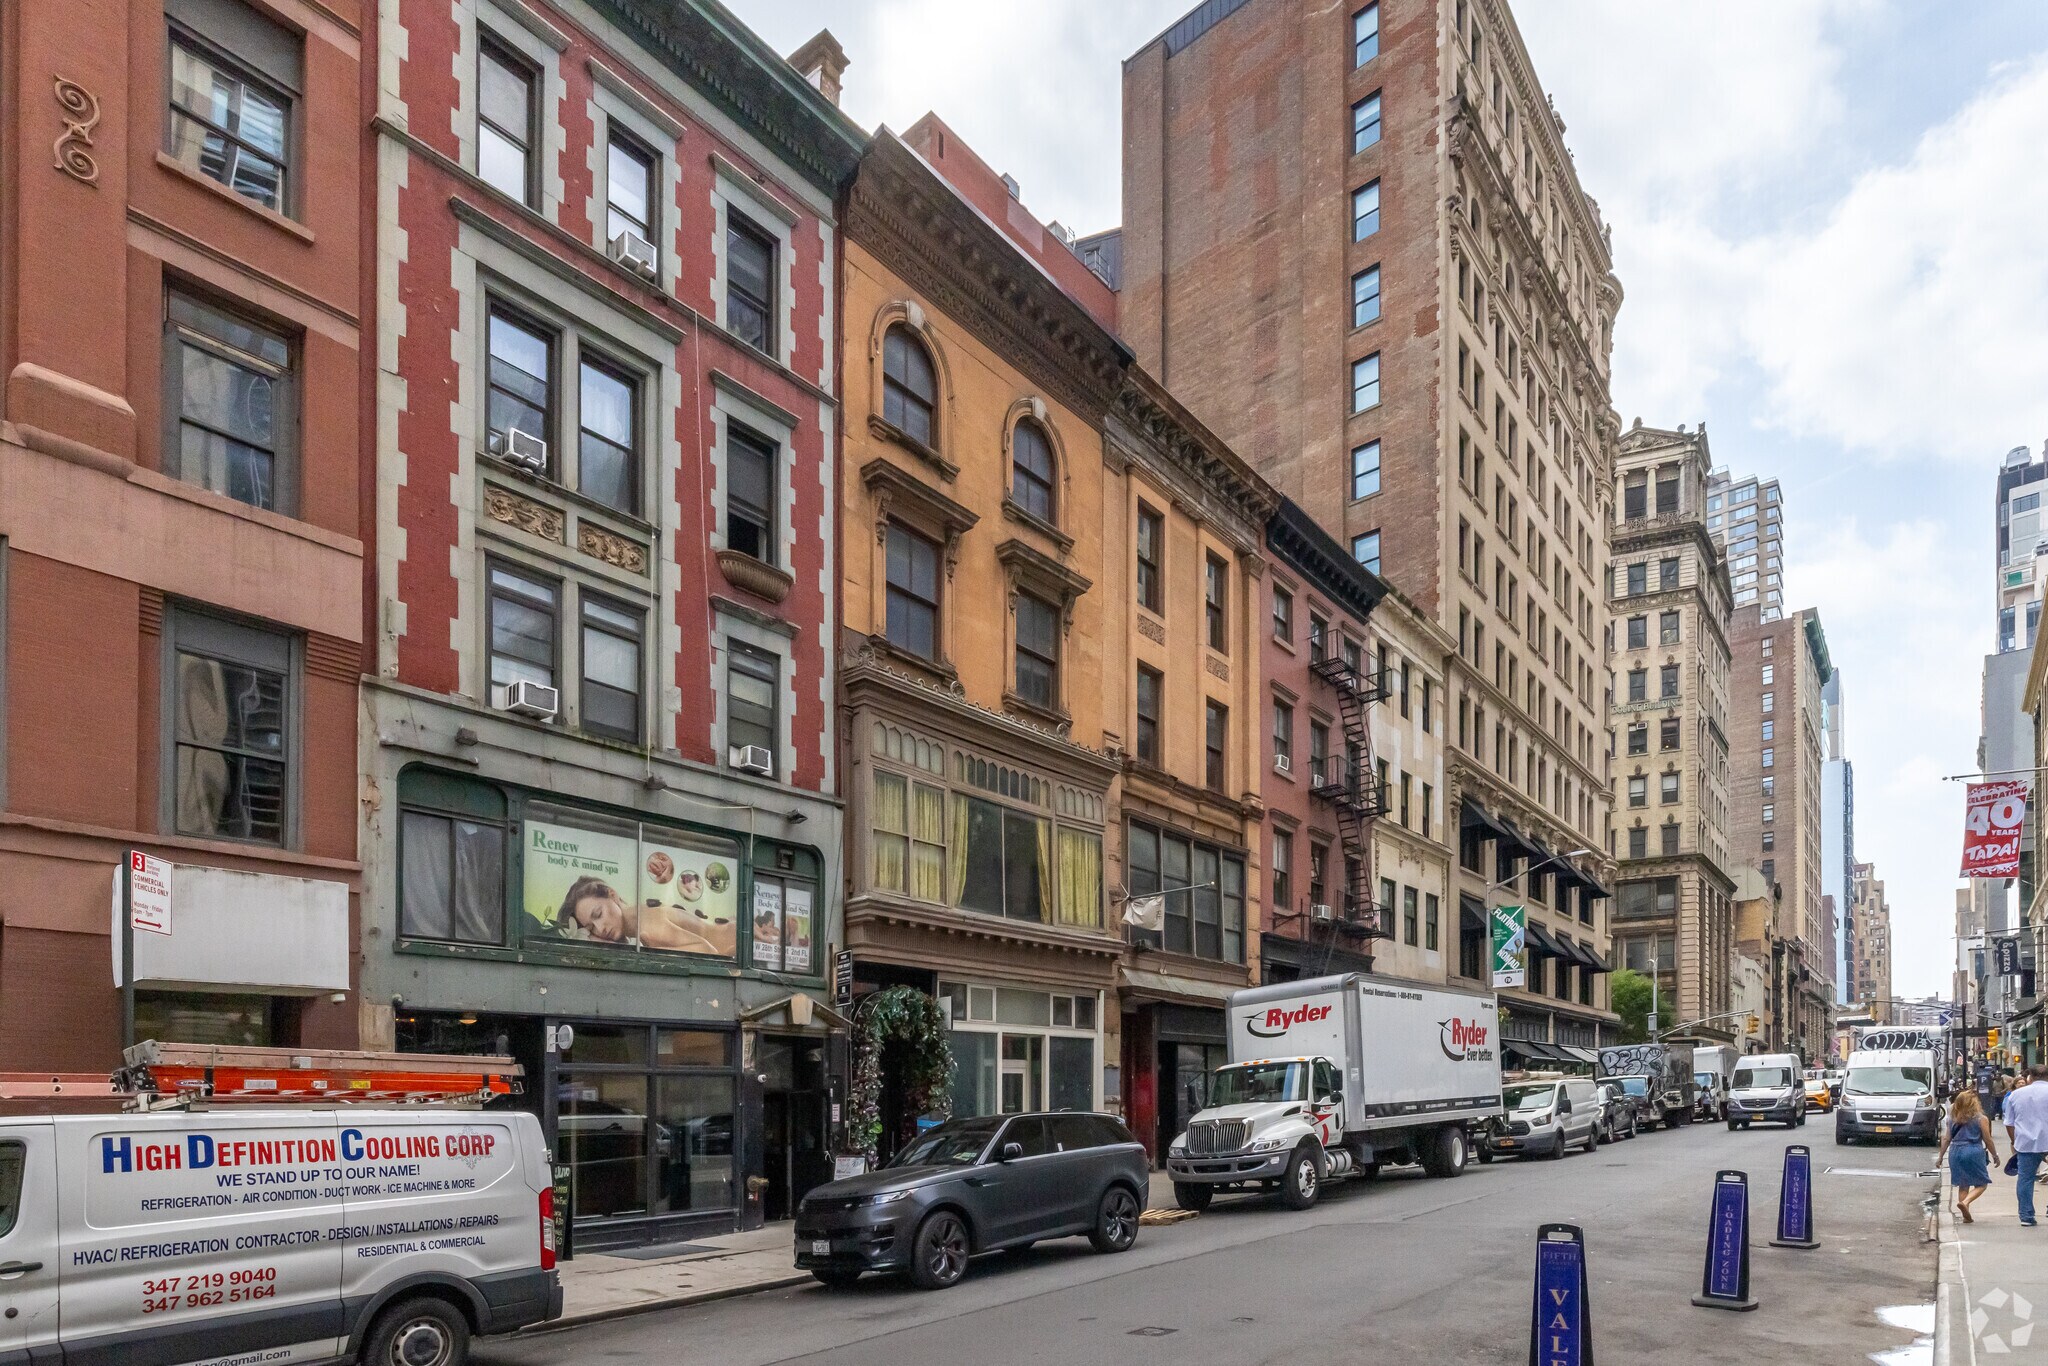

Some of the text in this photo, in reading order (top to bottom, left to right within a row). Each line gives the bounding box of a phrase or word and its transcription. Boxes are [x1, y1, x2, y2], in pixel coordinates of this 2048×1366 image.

[1967, 786, 2027, 804] CELEBRATING
[1966, 797, 2026, 837] 40
[532, 829, 579, 853] Renew
[1965, 837, 2019, 861] TADA!
[135, 855, 142, 870] 3
[547, 854, 619, 875] body & mind spa
[134, 874, 164, 889] COMMERCIAL
[134, 883, 169, 897] VEHICLES ONLY
[755, 884, 780, 899] Renew
[134, 901, 149, 911] Monday
[152, 905, 164, 914] Friday
[758, 899, 771, 908] Body
[799, 906, 808, 915] Spa
[1493, 907, 1521, 933] FLATIRON
[1496, 948, 1520, 970] NOMAD
[2001, 941, 2014, 973] &pizza
[1265, 1004, 1332, 1030] Ryder
[1452, 1018, 1487, 1051] Ryder
[1467, 1048, 1477, 1061] Ever
[102, 1128, 495, 1173] HIGH DEFINITION COOLING CORP
[216, 1164, 421, 1187] WE STAND UP TO OUR NAME!
[141, 1194, 231, 1211] REFRIGERATION
[242, 1193, 259, 1204] AIR
[262, 1189, 317, 1203] CONDITION
[324, 1186, 350, 1198] DUCT
[352, 1184, 381, 1196] WORK
[387, 1182, 402, 1194] ICE
[403, 1180, 442, 1192] MACHINE
[444, 1180, 450, 1189] &
[451, 1179, 475, 1189] MORE
[1791, 1170, 1800, 1209] LOADING
[121, 1238, 229, 1261] REFRIGERATION
[235, 1230, 320, 1250] CONTRACTOR
[328, 1225, 369, 1241] DESIGN
[376, 1218, 453, 1236] INSTALLATIONS
[459, 1214, 499, 1228] REPAIRS
[357, 1236, 486, 1258] RESIDENTIAL & COMMERCIAL
[1721, 1204, 1734, 1290] LOADING ZONE
[1543, 1251, 1577, 1261] FIFTH
[142, 1267, 277, 1295] 347 219 9040
[142, 1284, 276, 1314] 347 962 5164
